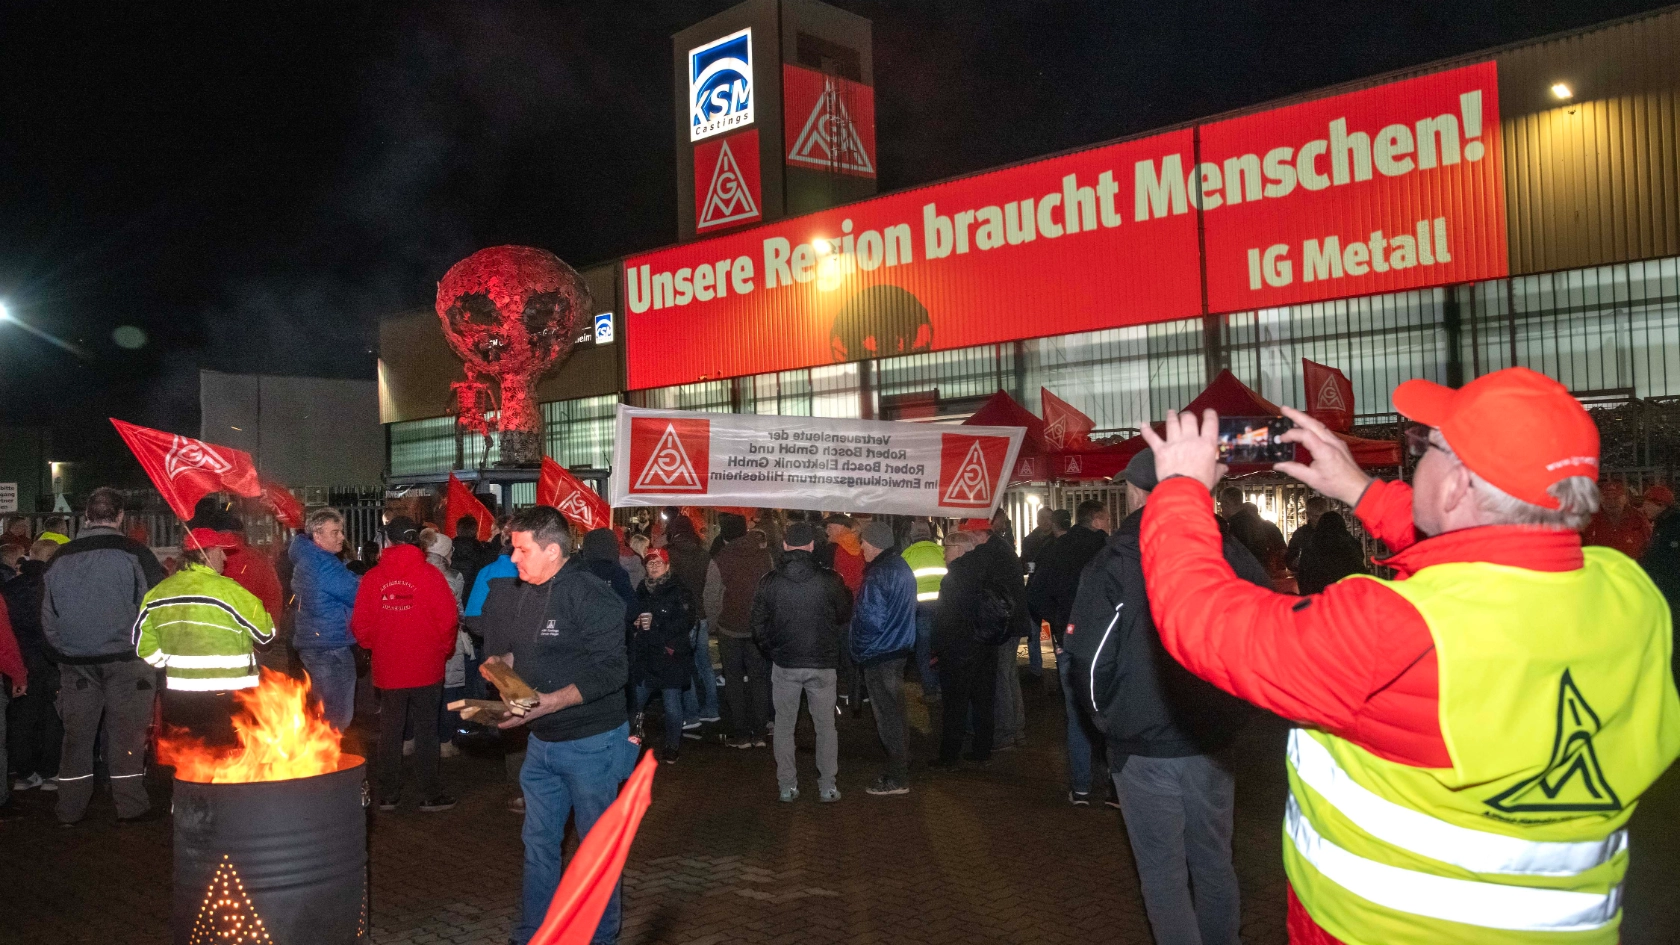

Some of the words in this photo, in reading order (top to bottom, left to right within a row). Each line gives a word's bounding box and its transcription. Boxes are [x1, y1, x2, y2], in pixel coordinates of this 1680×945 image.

[692, 79, 751, 126] KSM
[695, 112, 749, 136] Castings
[626, 264, 755, 314] Unsere
[763, 218, 913, 292] Region
[923, 169, 1122, 261] braucht
[1134, 88, 1485, 222] Menschen!
[1247, 243, 1293, 291] IG
[1302, 216, 1452, 282] Metall
